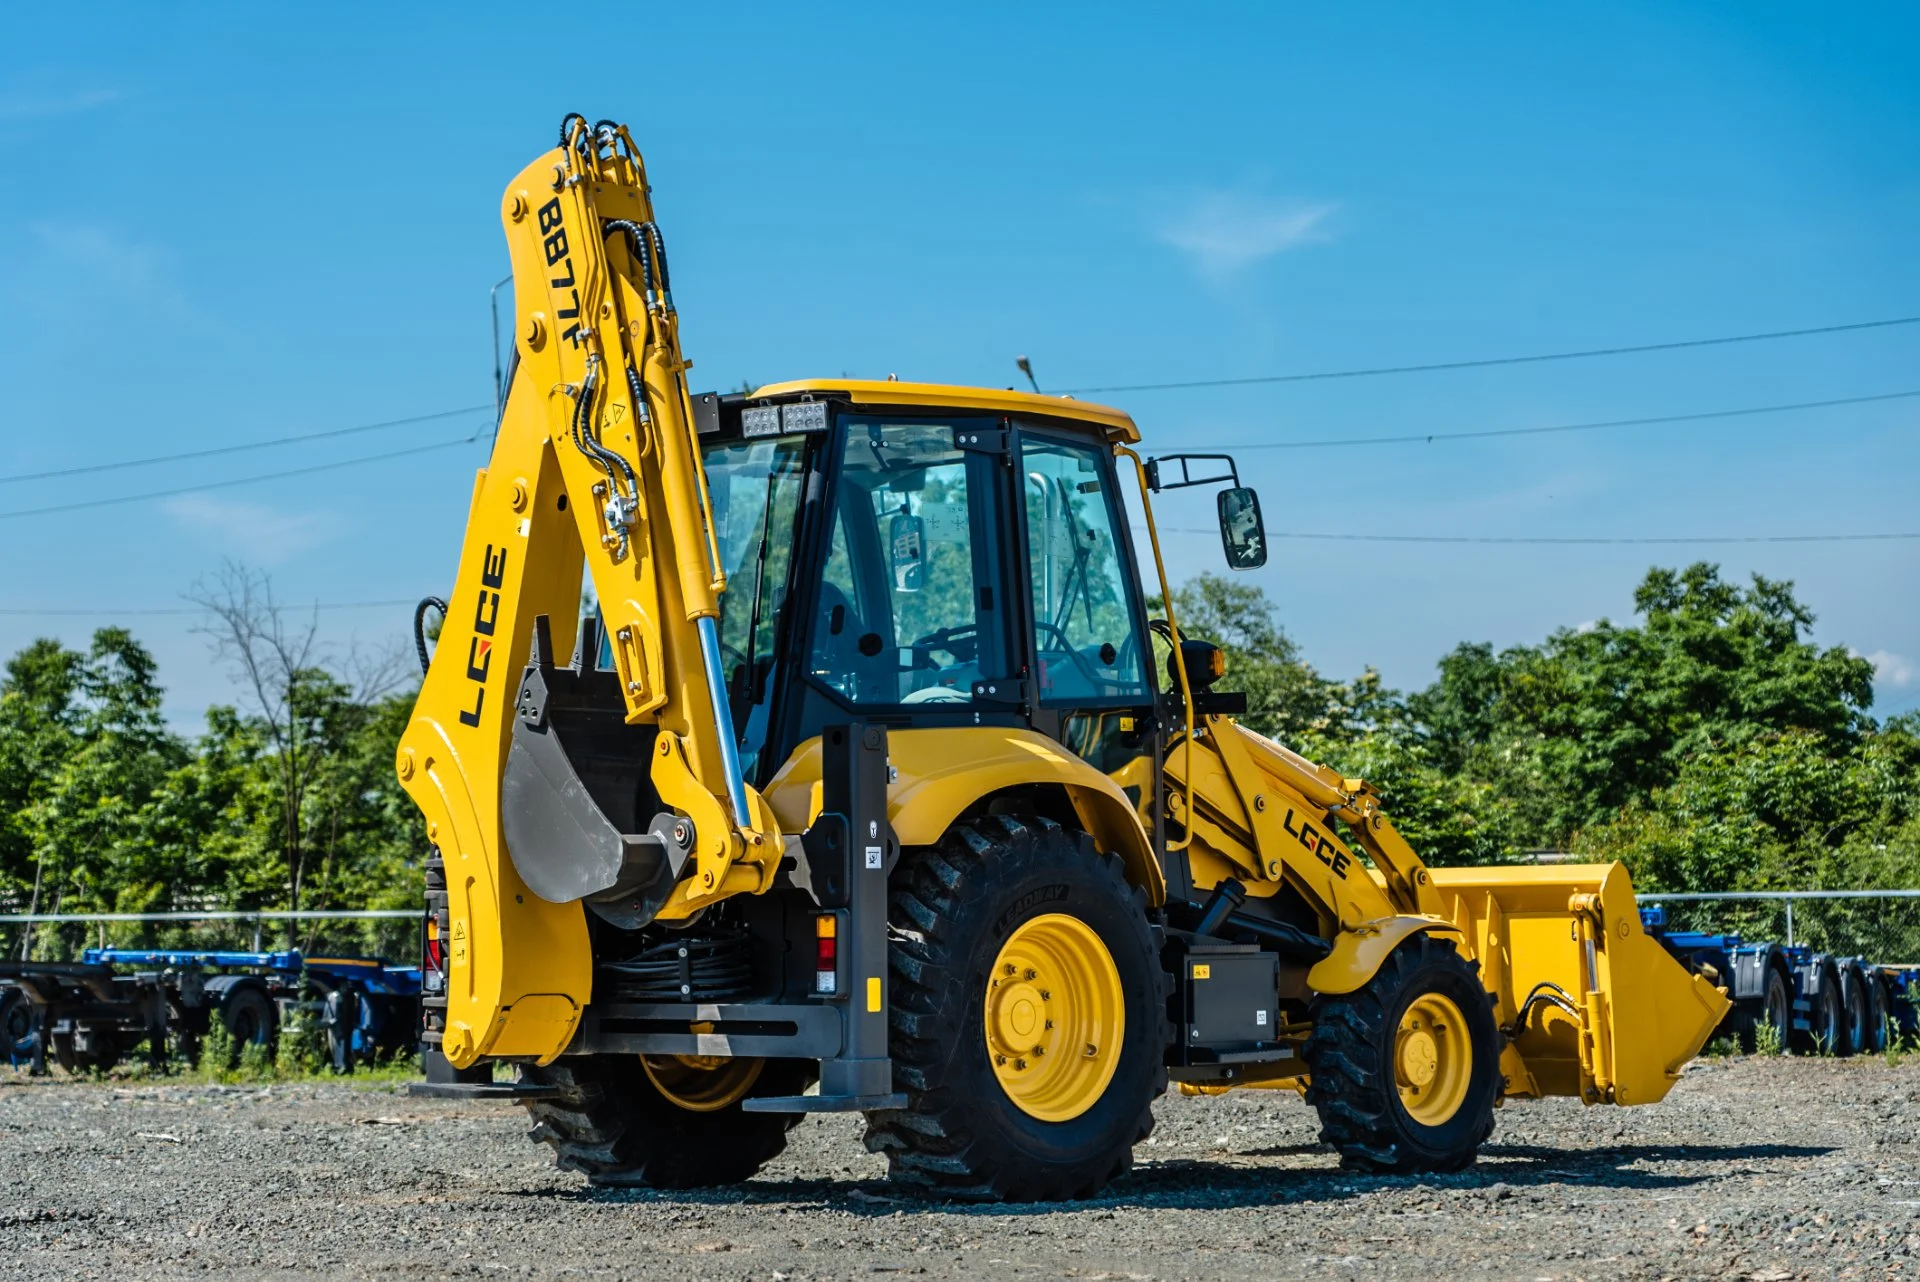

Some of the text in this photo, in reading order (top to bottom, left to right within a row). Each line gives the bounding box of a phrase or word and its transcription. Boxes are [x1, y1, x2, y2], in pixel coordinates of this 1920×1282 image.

[460, 544, 506, 728] LGCE
[1284, 808, 1351, 880] LGCE
[998, 886, 1064, 931] LEADWAY
